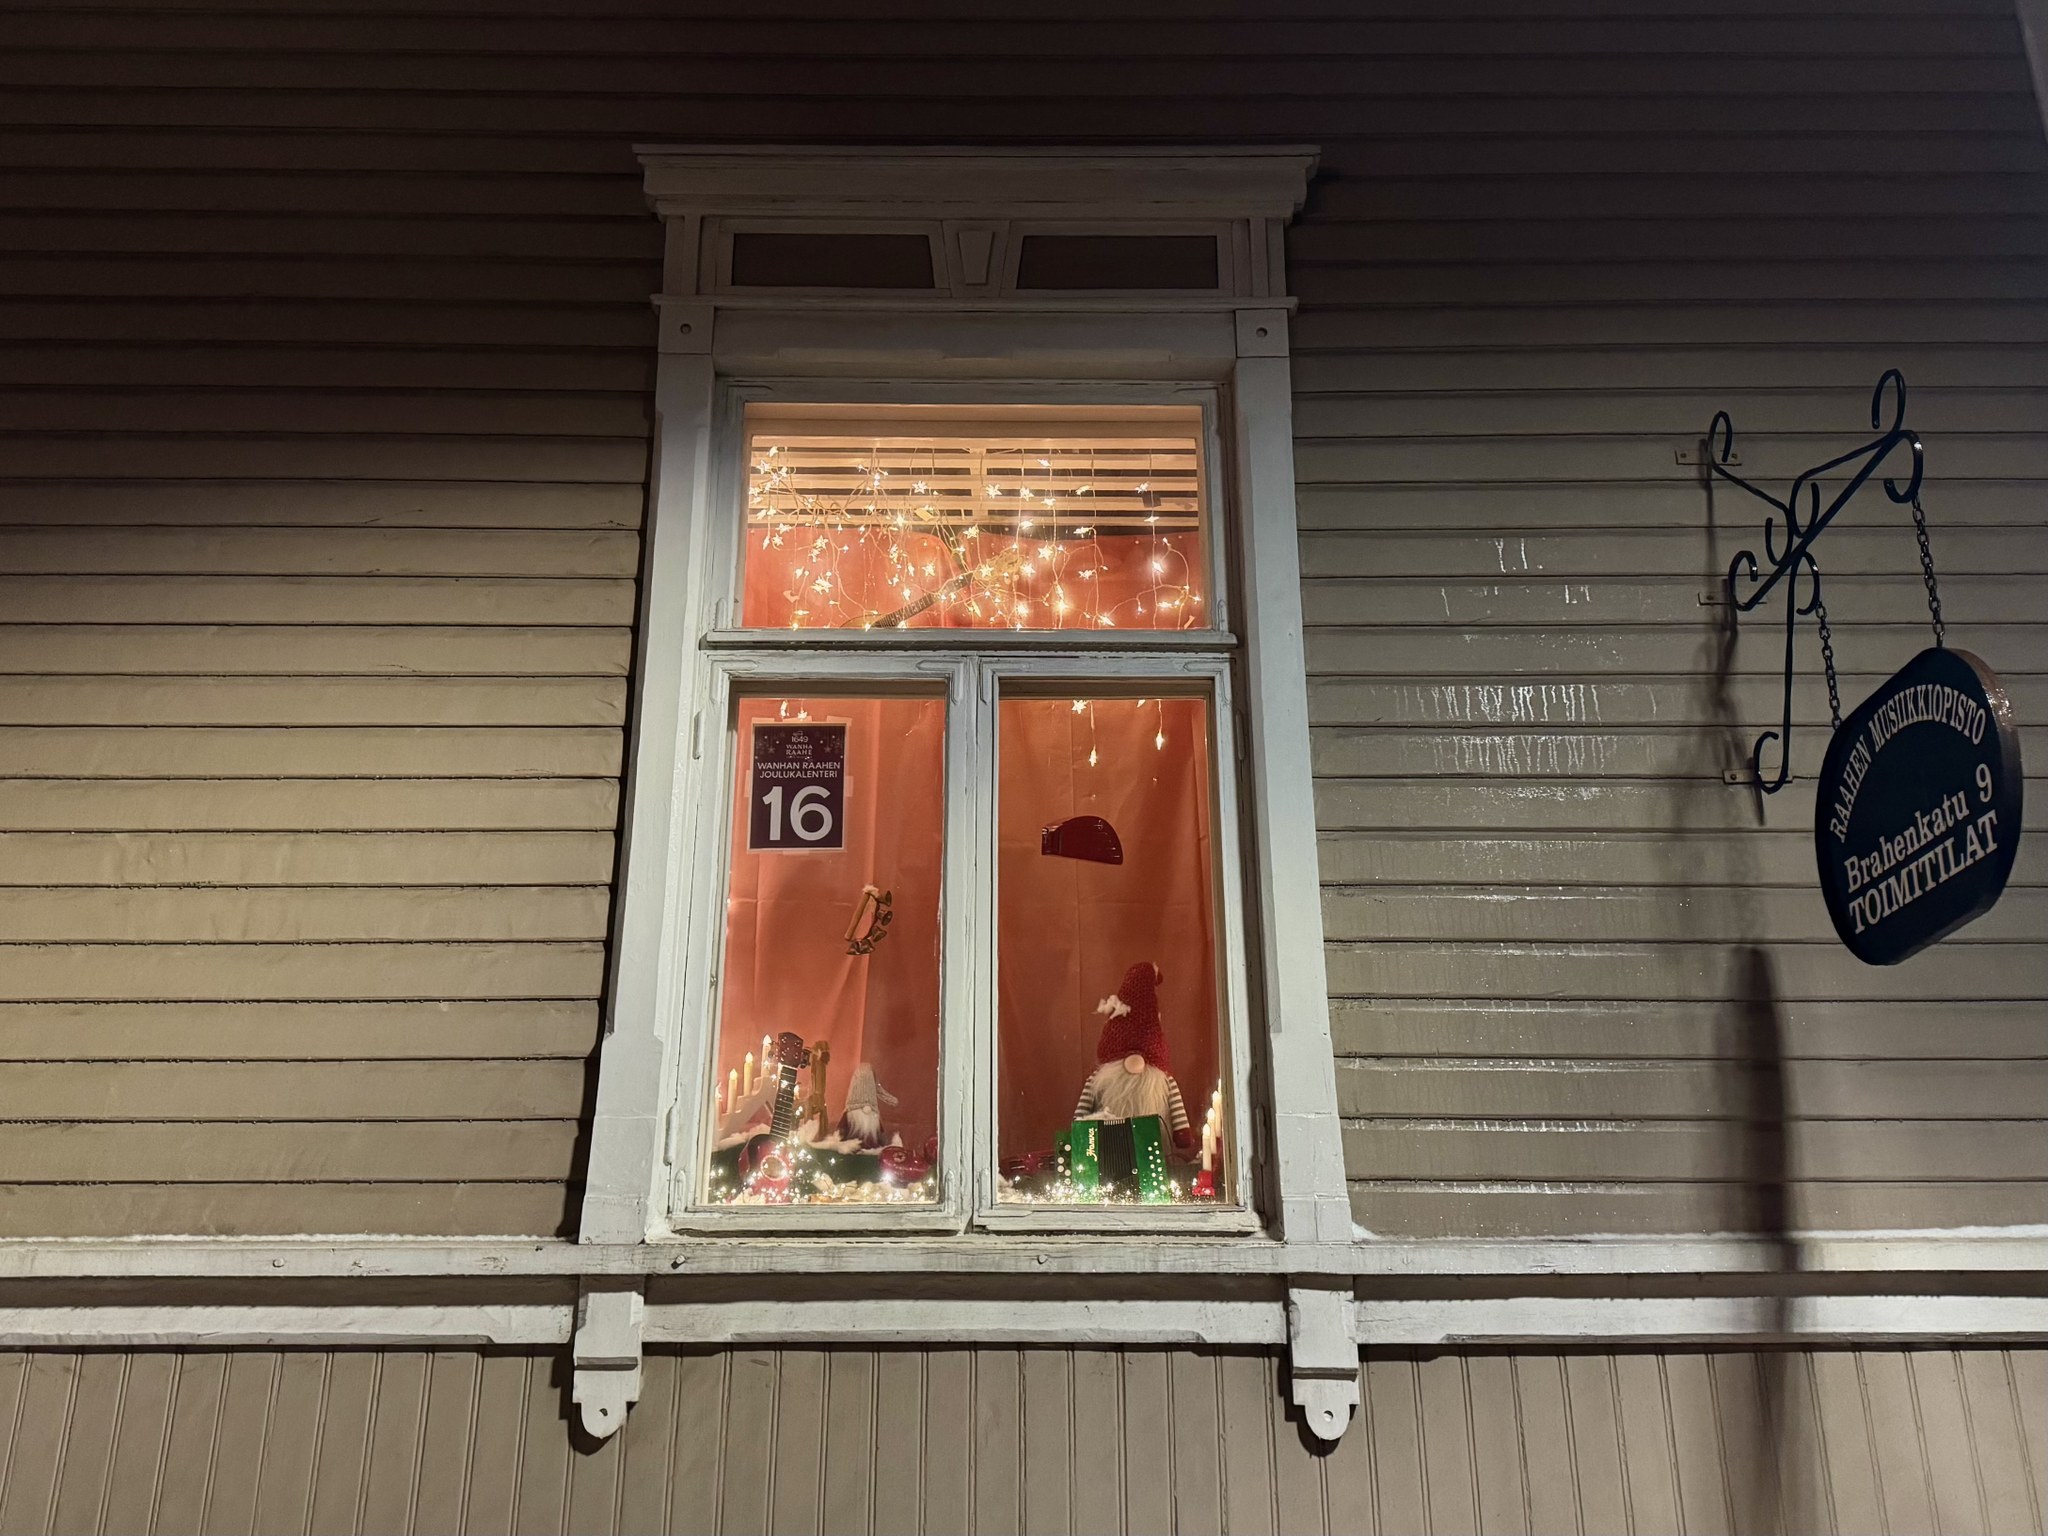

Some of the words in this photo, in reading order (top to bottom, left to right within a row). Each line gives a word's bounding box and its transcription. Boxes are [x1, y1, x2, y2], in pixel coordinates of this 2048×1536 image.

[757, 761, 800, 769] WANHAN
[802, 761, 841, 769] RAAHEN
[759, 770, 838, 779] JOULUKALENTERI
[1830, 734, 1871, 843] RAAHEN
[1868, 684, 1987, 746] MUSIIKKIOPISTO
[762, 785, 833, 841] 16
[1844, 789, 1970, 894] Brahenkatu
[1975, 763, 1994, 803] 9
[1849, 809, 1998, 935] TOIMITILAT
